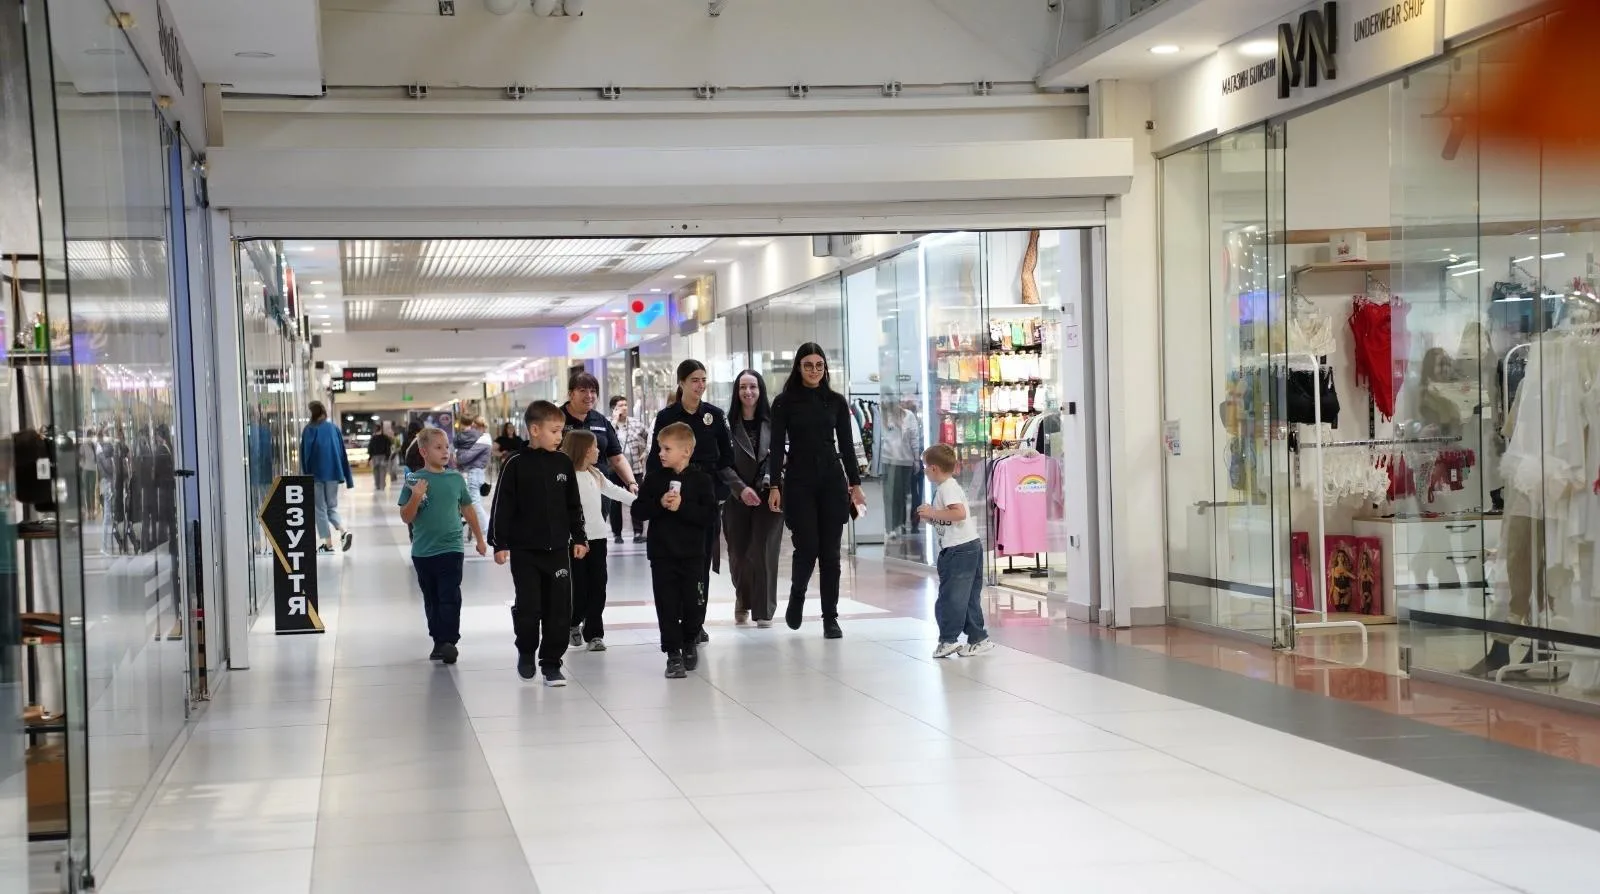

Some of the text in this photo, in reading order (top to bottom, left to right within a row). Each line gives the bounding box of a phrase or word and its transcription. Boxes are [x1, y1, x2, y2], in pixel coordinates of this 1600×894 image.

[1354, 0, 1425, 42] UNDERWEAR SHOP
[1222, 58, 1276, 95] МАГАЗИН БІЛИЗНИ
[285, 485, 306, 616] ВЗУТТЯ
